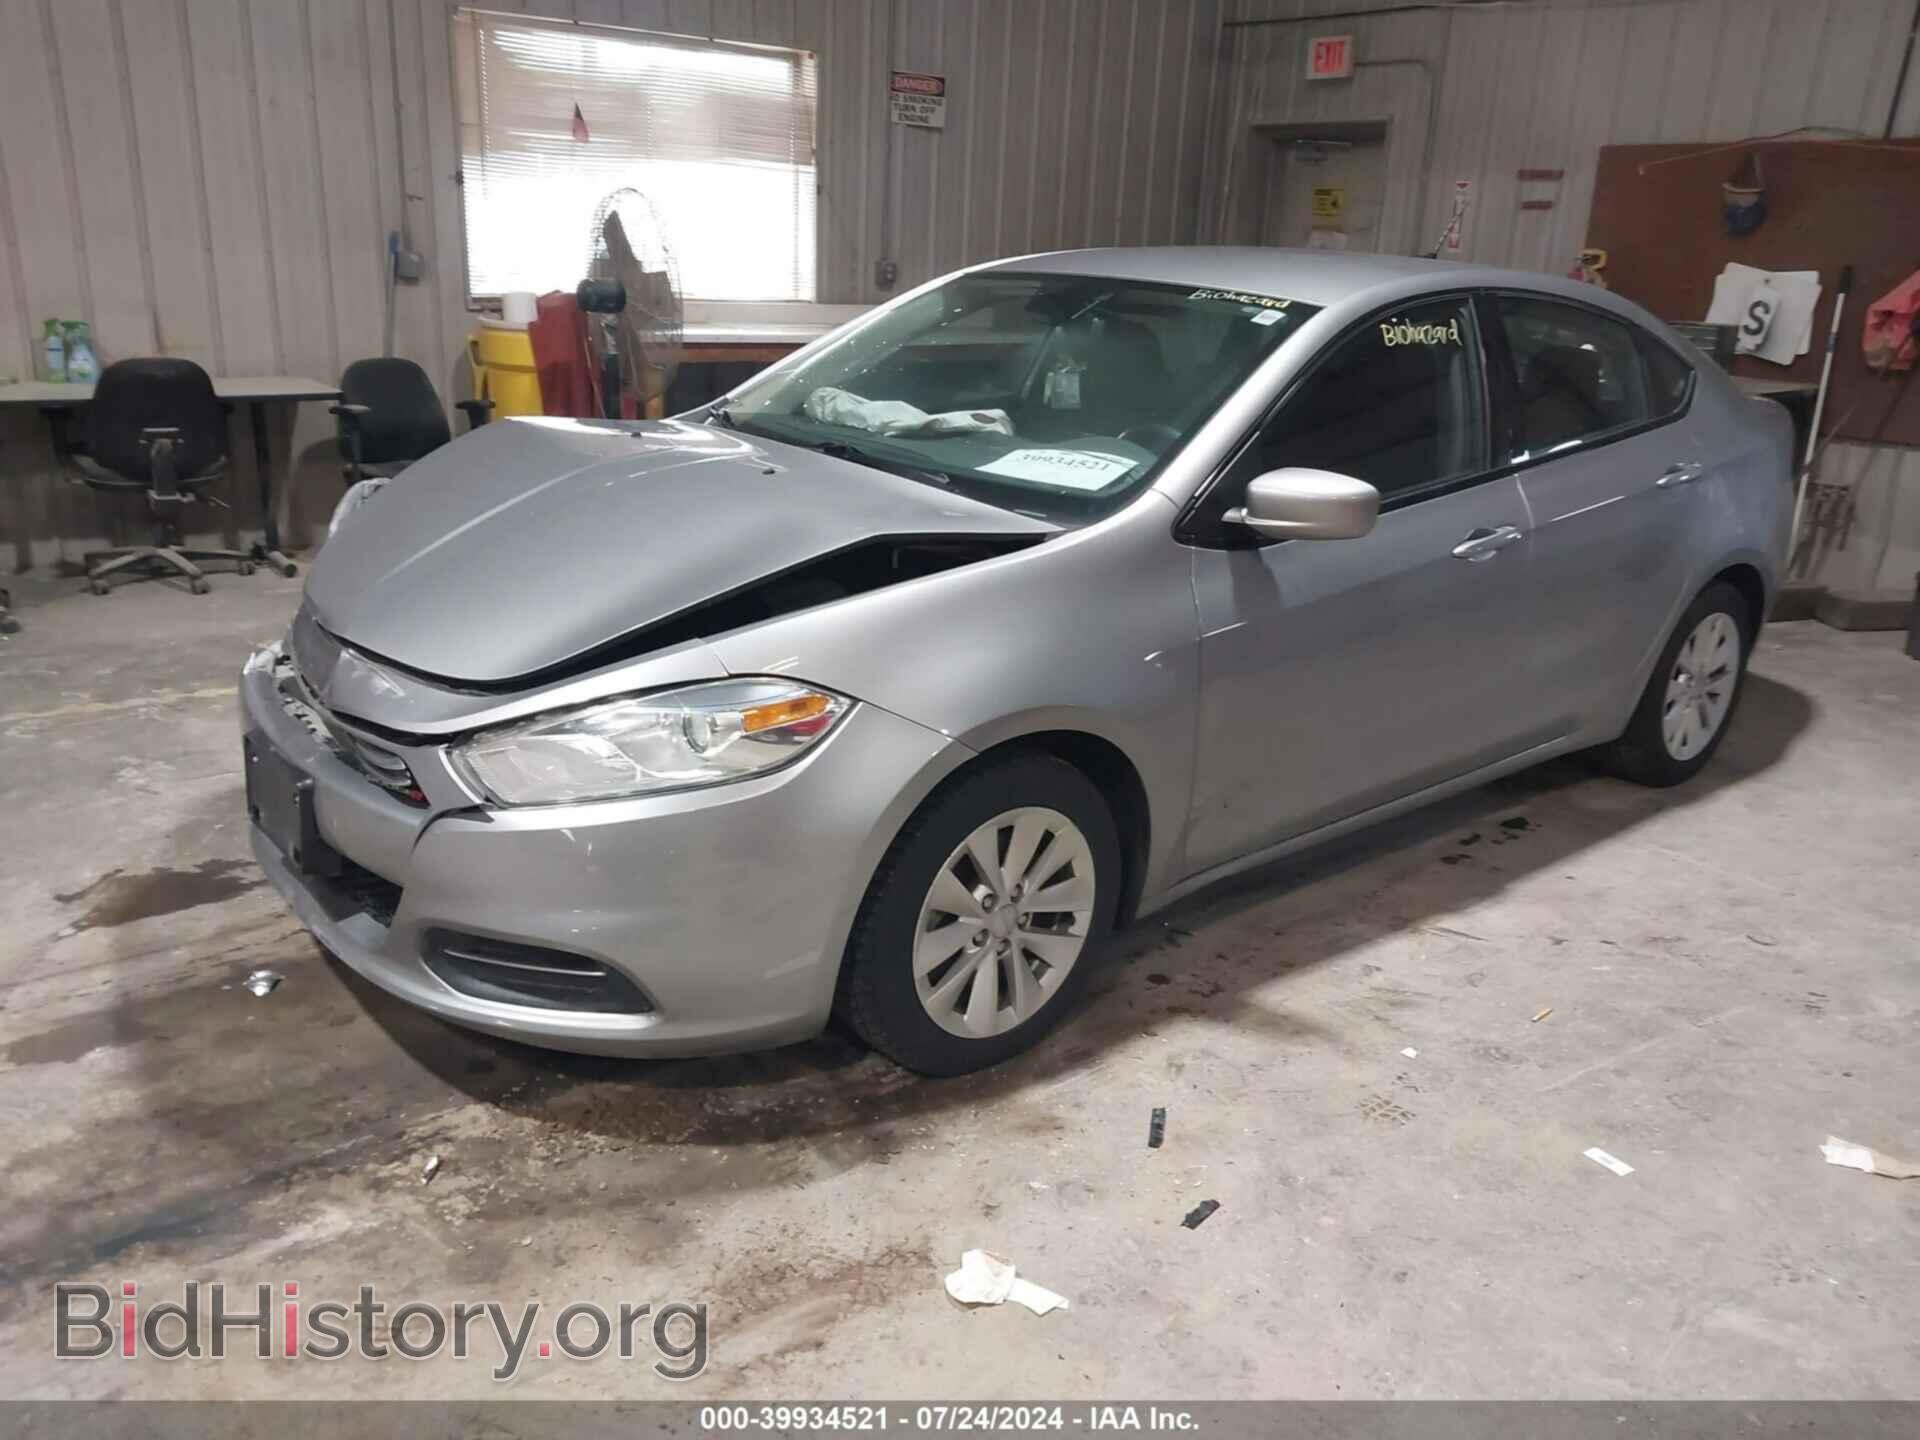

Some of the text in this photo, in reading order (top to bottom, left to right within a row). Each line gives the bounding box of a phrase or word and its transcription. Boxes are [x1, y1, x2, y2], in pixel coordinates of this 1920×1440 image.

[1313, 40, 1345, 73] EXIT
[903, 95, 943, 107] SMOKING
[893, 102, 937, 114] TURN OFF
[897, 112, 930, 124] ENGINE
[1743, 300, 1771, 337] S
